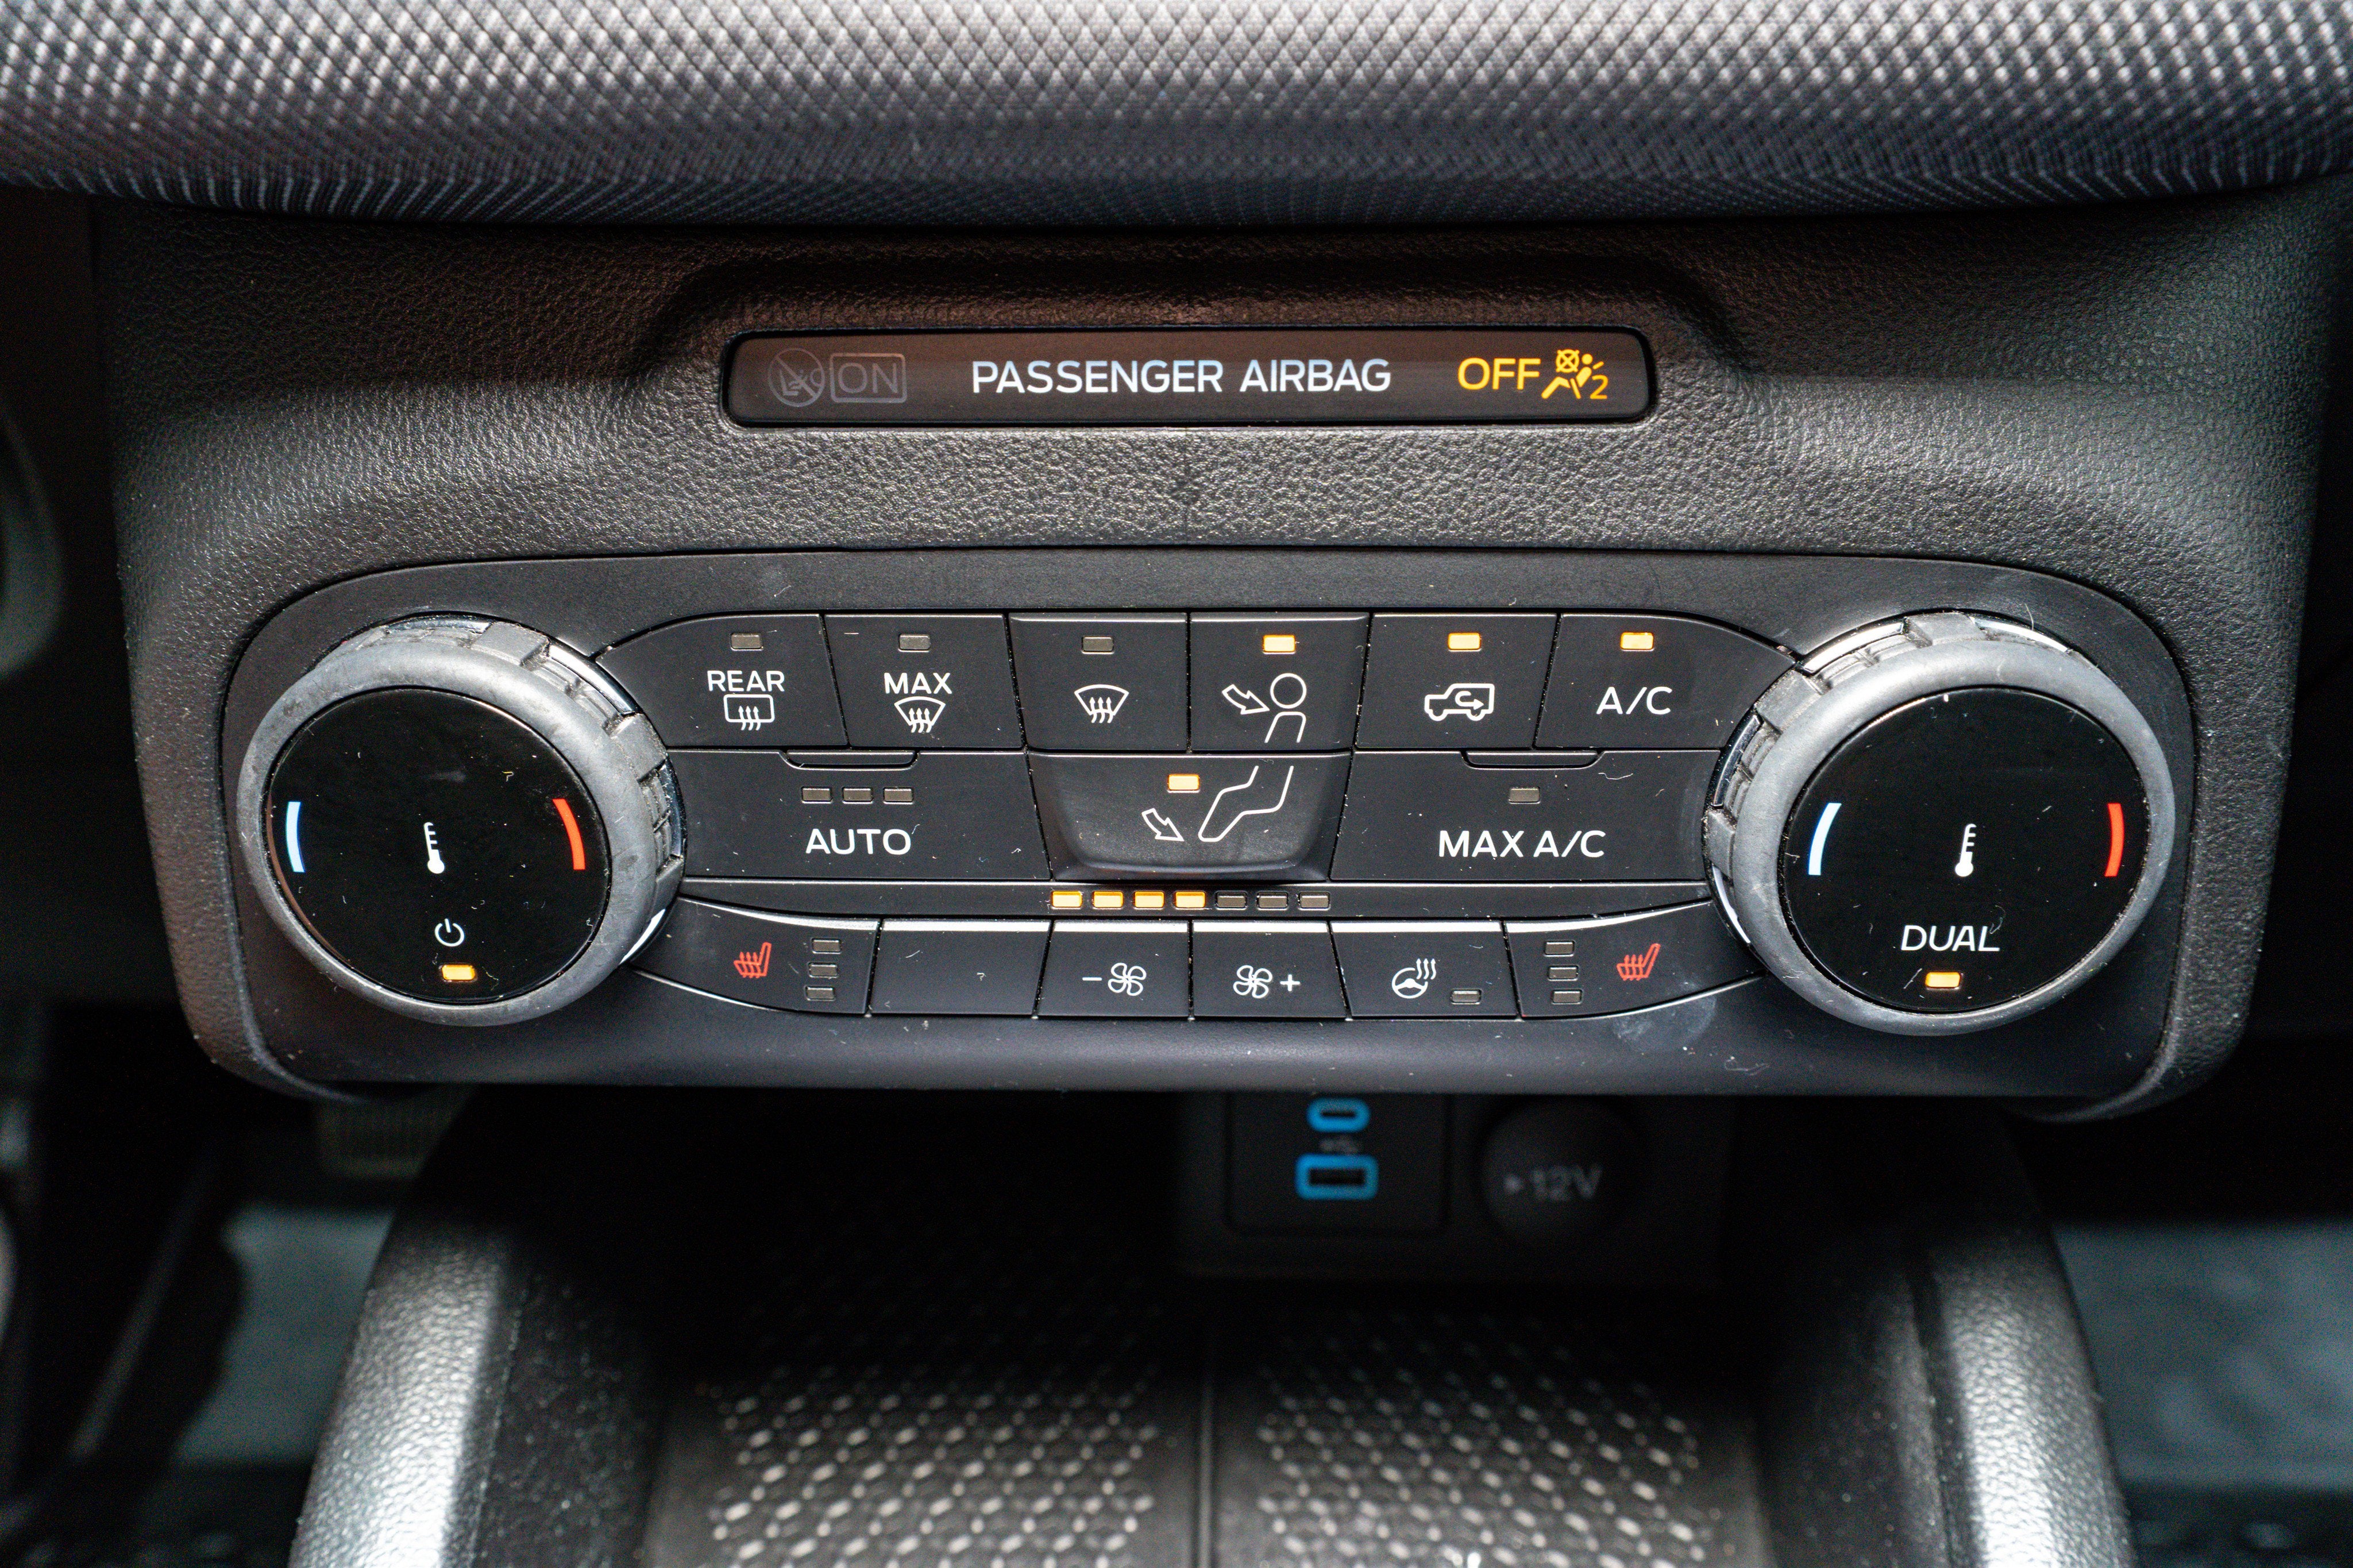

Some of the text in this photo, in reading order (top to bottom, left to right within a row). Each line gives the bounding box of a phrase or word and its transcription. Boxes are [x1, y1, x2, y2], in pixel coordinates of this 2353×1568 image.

[837, 362, 898, 395] ON
[972, 358, 1392, 393] PASSENGER AIRBAG
[1457, 357, 1541, 390] OFF
[707, 670, 785, 692] REAR
[884, 672, 952, 694] MAX
[1596, 686, 1672, 715] A/C
[805, 828, 912, 855] AUTO
[1438, 830, 1606, 858] MAX A/C
[1900, 925, 2000, 951] DUAL
